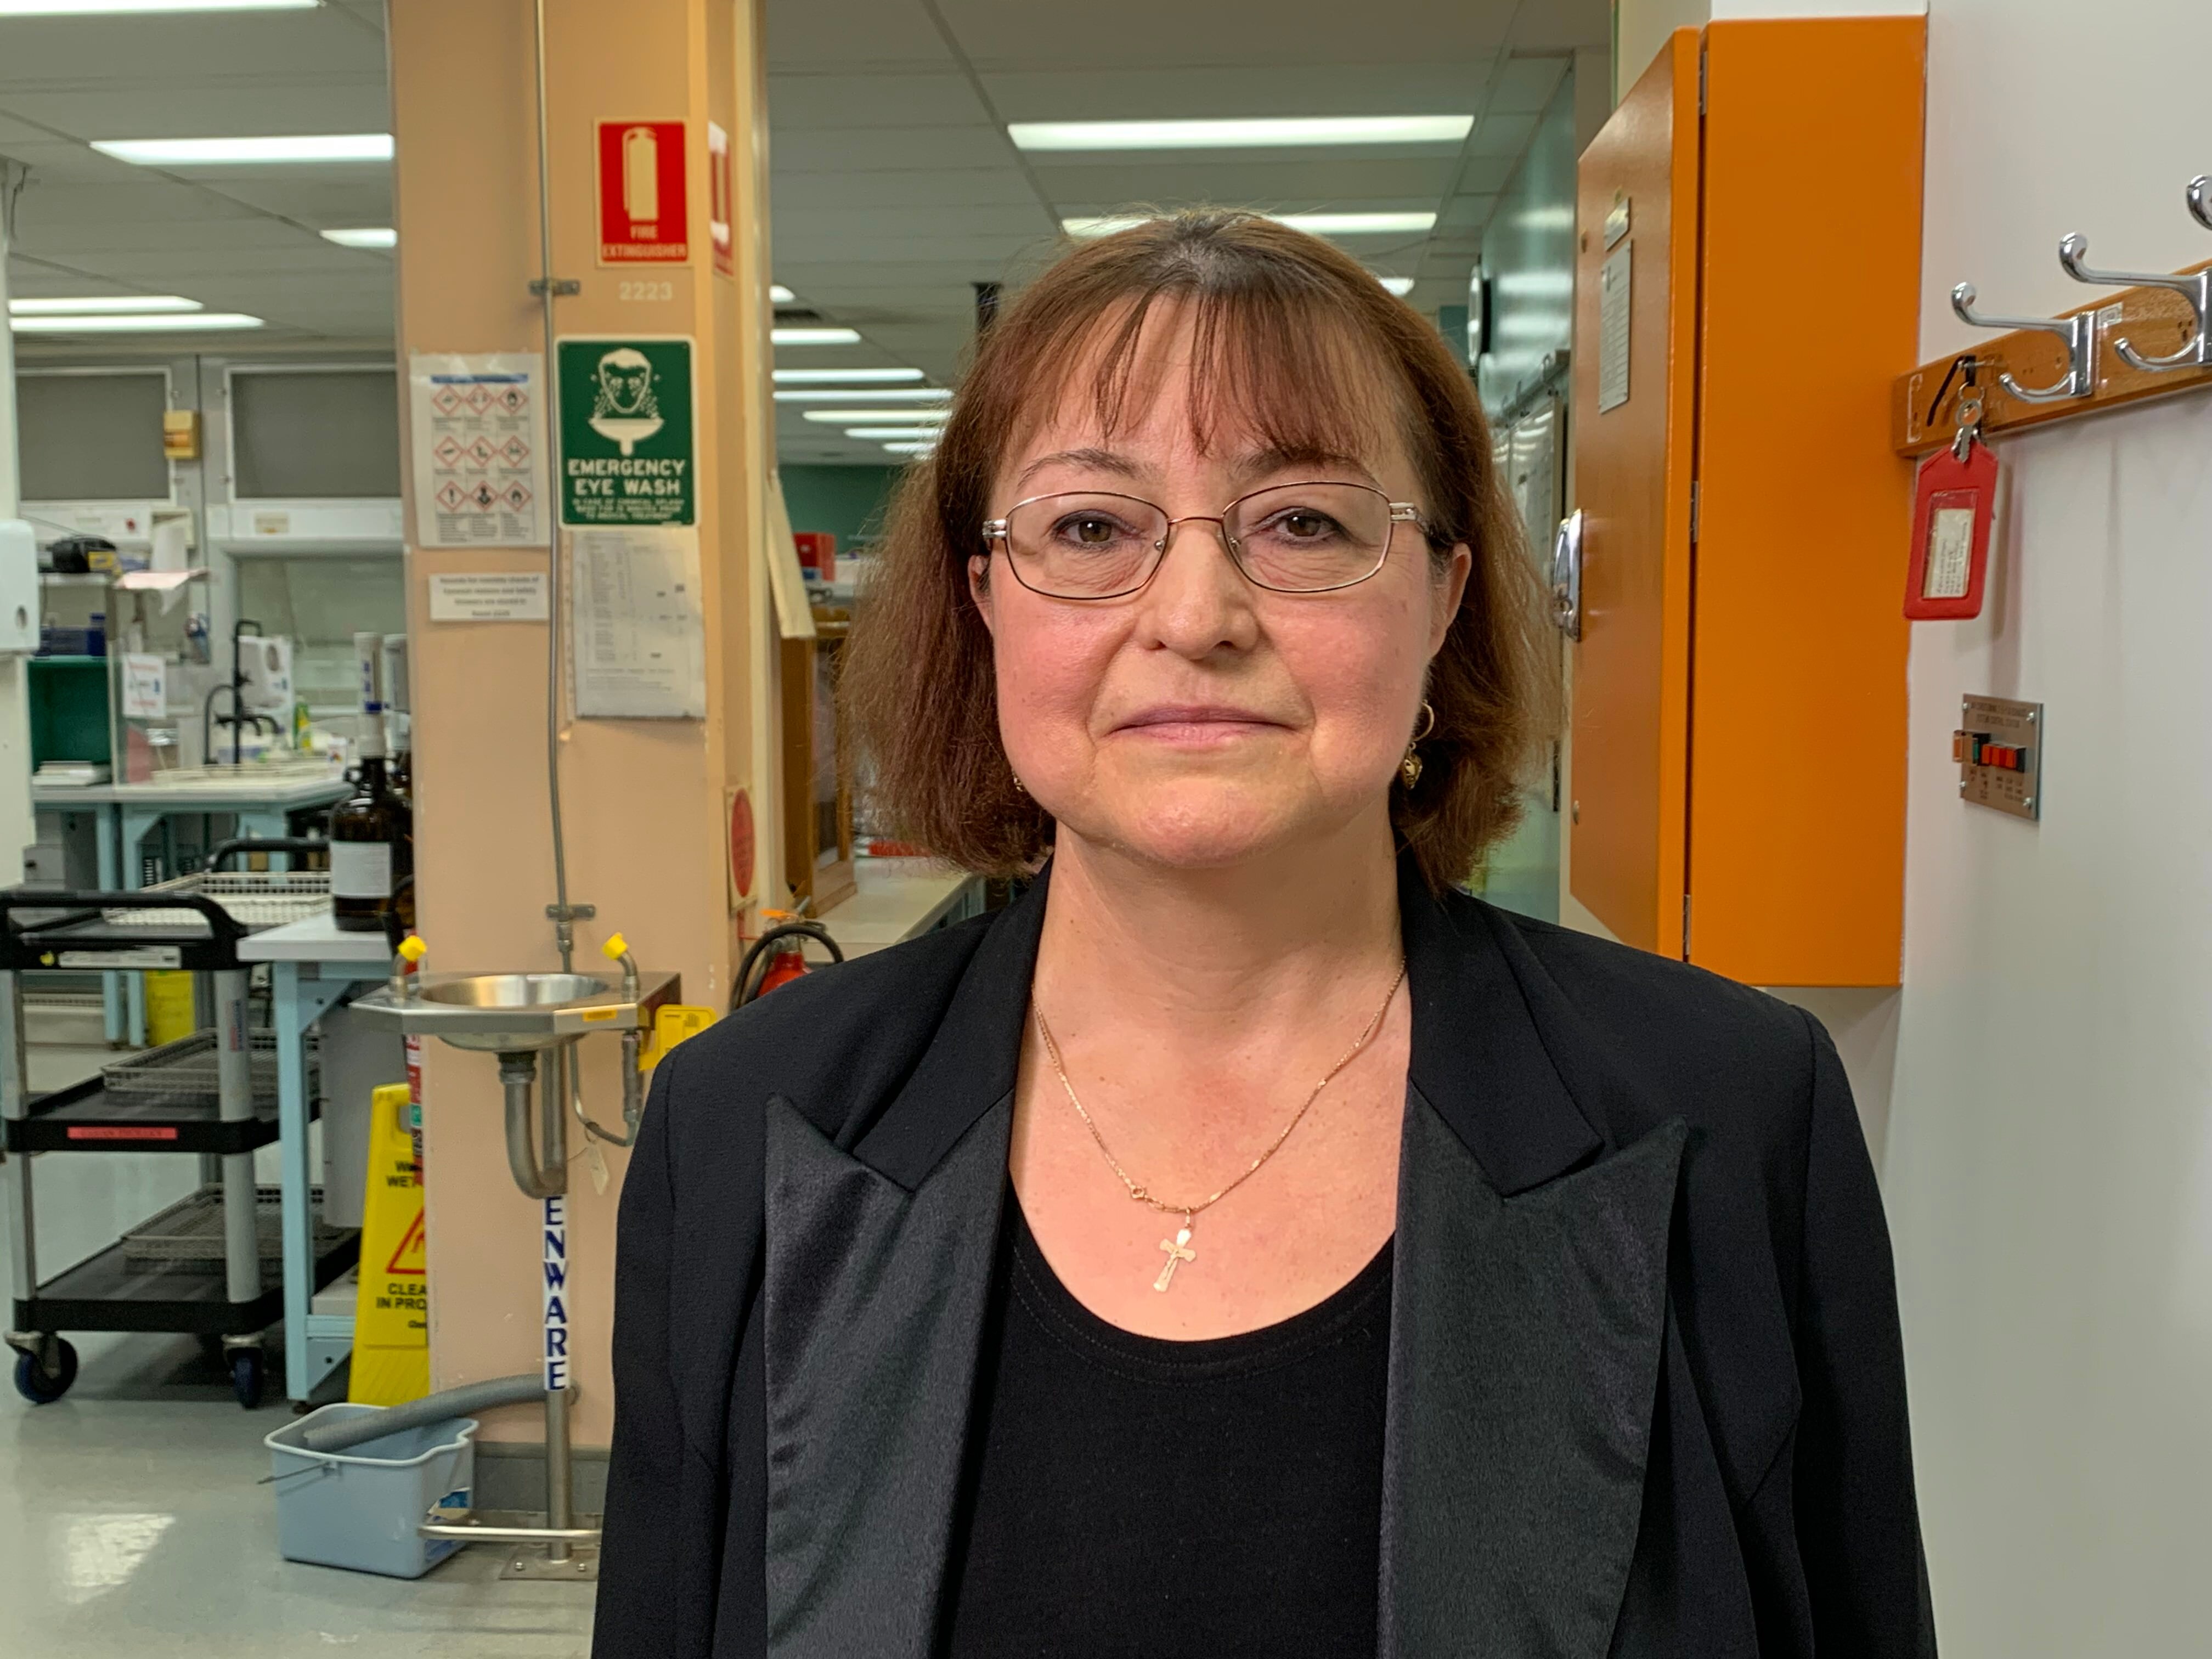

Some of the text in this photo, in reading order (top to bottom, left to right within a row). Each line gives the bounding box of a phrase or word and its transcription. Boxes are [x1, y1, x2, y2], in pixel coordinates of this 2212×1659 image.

[630, 225, 657, 239] FIRE
[603, 244, 686, 258] EXTINGUISHER
[620, 281, 672, 300] 2223
[568, 459, 685, 476] EMERGENCY
[575, 478, 680, 495] EYE WASH
[544, 1195, 568, 1390] ENWARE
[376, 1297, 391, 1309] IN
